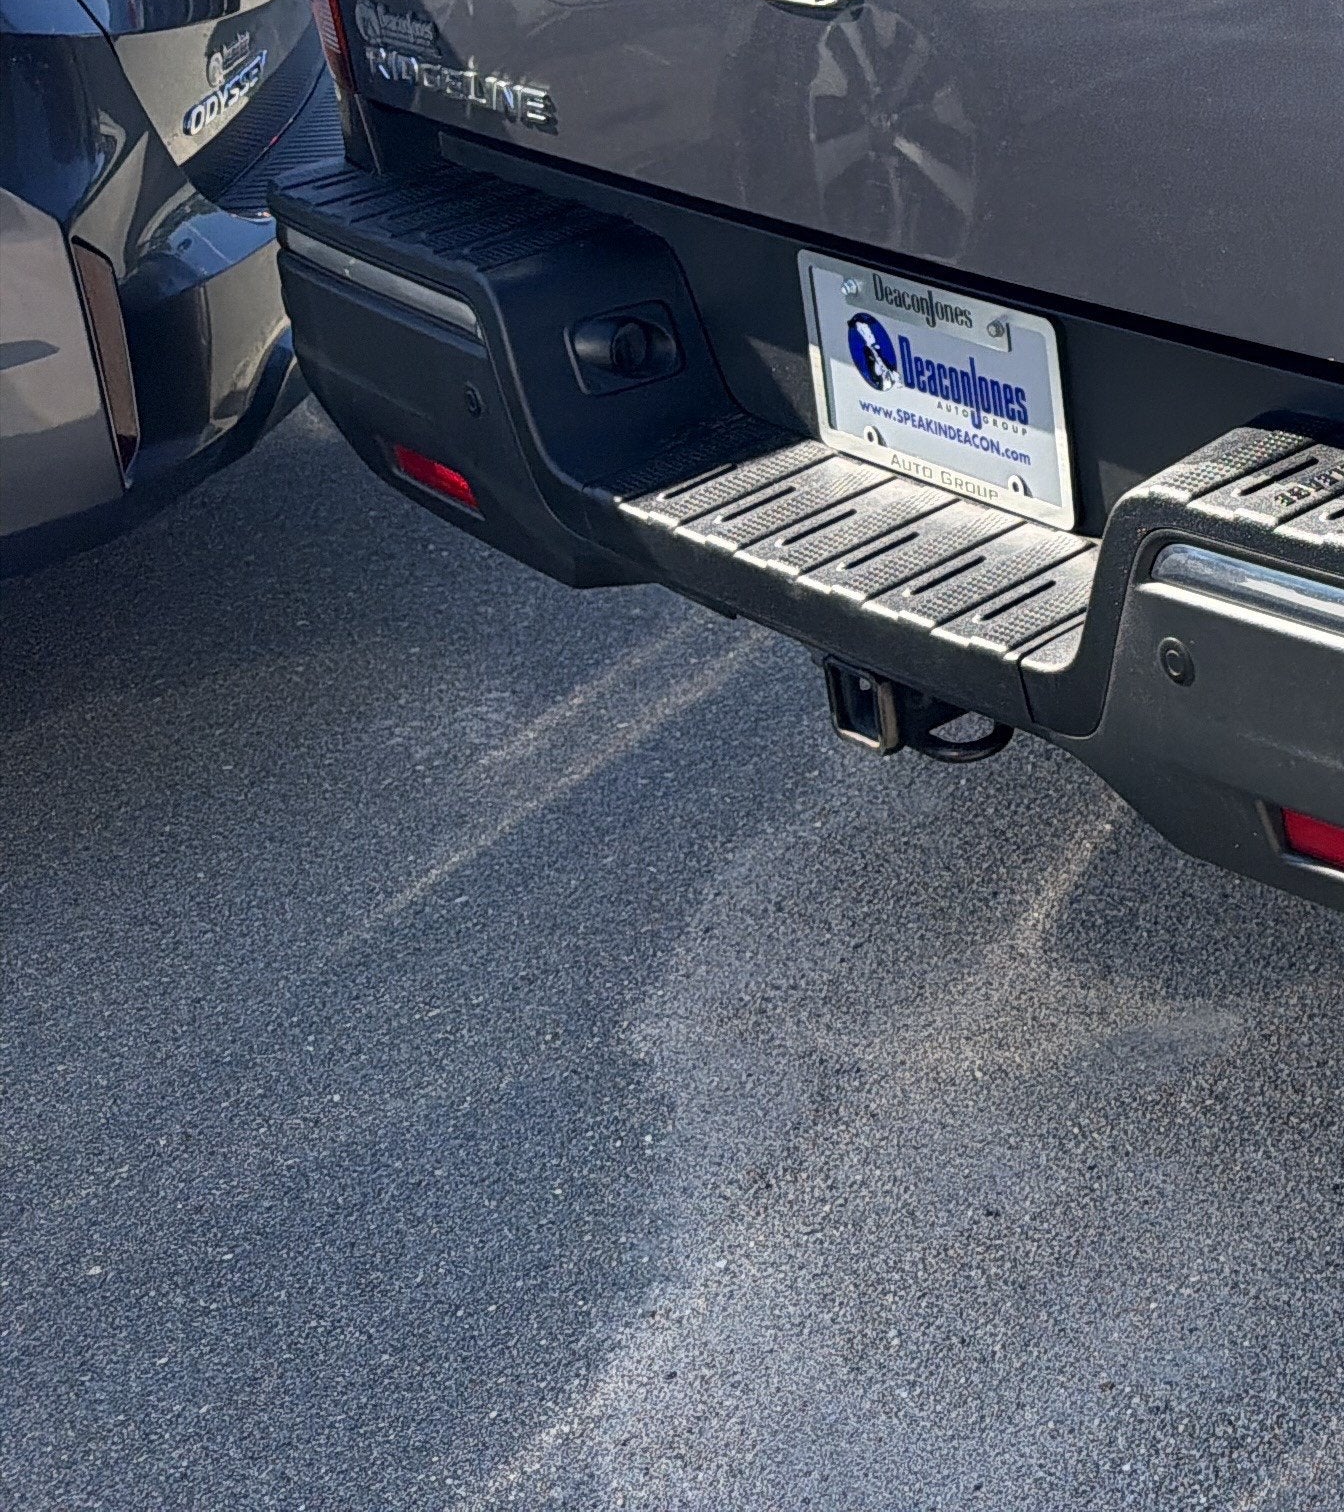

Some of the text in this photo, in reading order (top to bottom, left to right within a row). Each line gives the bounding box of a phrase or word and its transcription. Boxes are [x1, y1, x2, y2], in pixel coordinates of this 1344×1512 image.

[183, 50, 267, 135] ODYSSEY
[873, 273, 973, 328] DeaconJones
[897, 333, 1030, 430] DeaconJones
[858, 399, 1032, 466] www.SPEAKINDEACON.com
[936, 400, 1028, 436] AUTO GROUP
[890, 454, 999, 501] AUTO GROUP
